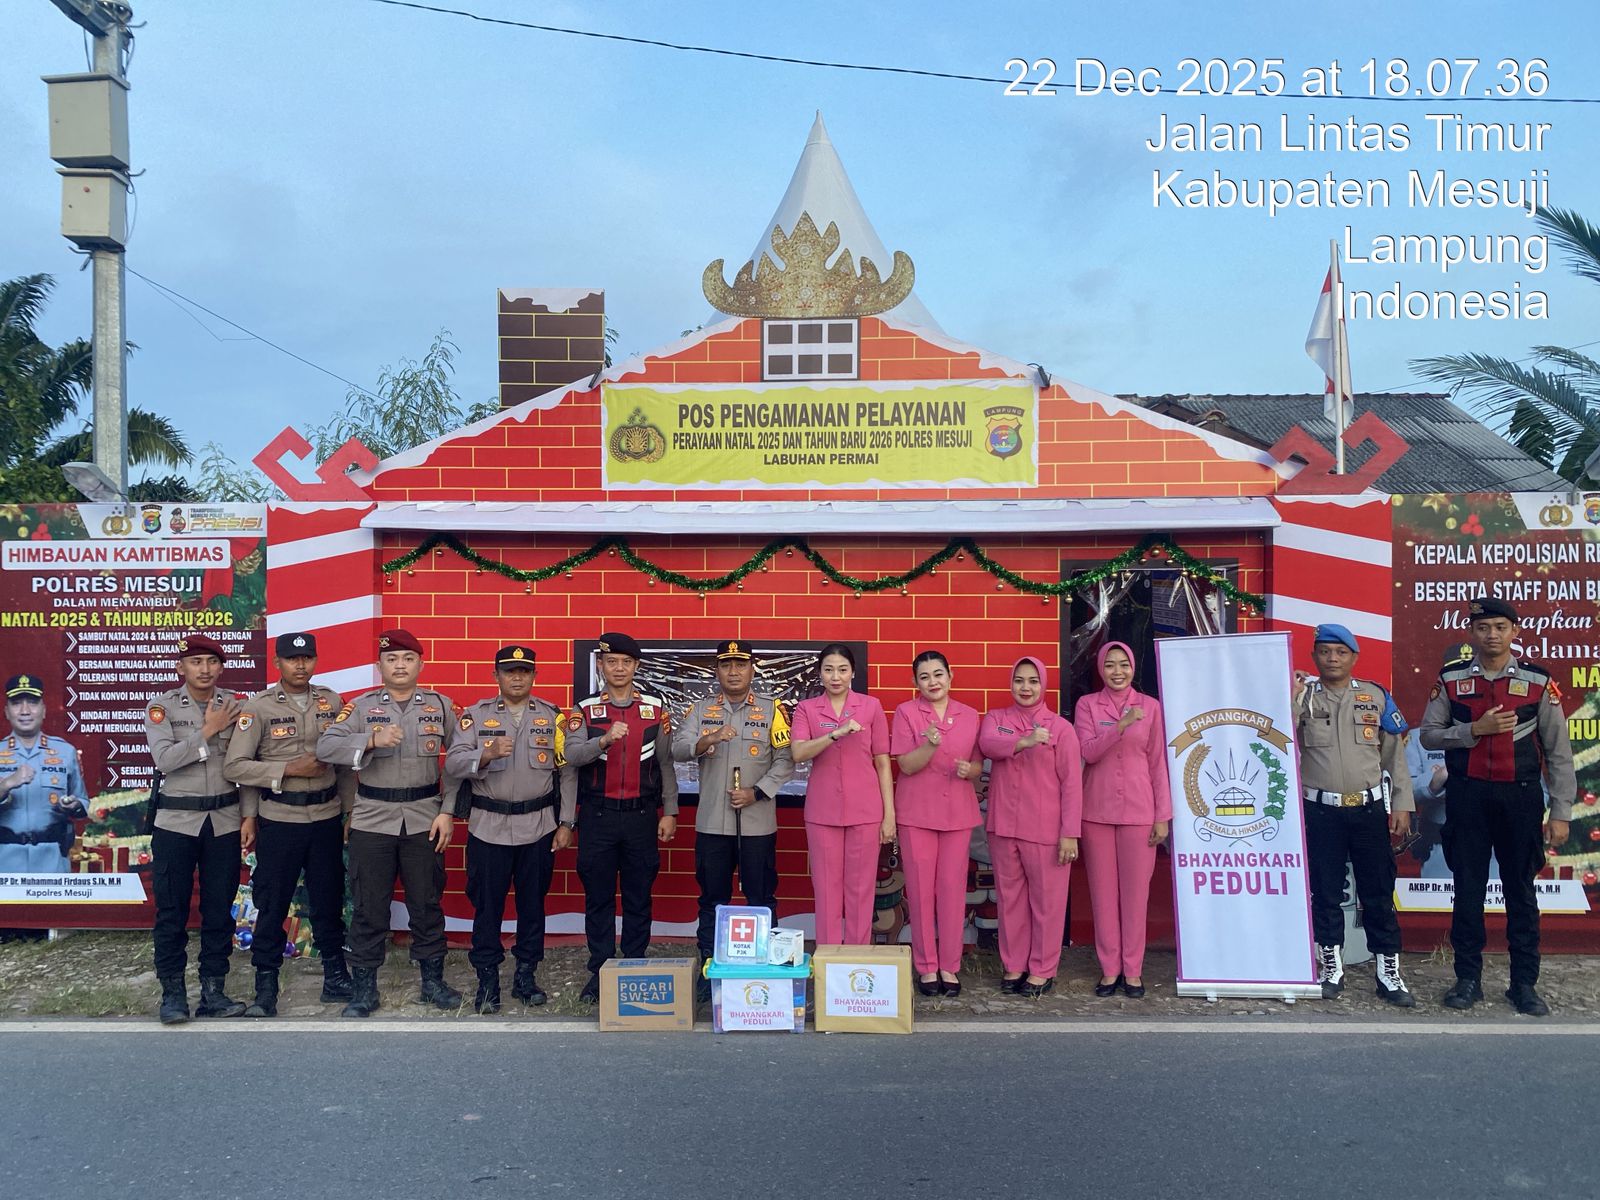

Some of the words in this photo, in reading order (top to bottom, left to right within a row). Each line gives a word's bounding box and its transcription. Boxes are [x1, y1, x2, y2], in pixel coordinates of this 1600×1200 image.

[678, 403, 715, 429] POS
[720, 402, 849, 428] PENGAMANAN
[855, 401, 966, 427] PELAYANAN
[986, 407, 1023, 416] LAMPUNG
[673, 432, 723, 450] PERAYAAN
[725, 432, 755, 449] NATAL
[757, 431, 780, 449] 2025
[782, 431, 802, 449] DAN
[805, 431, 838, 449] TAHUN
[840, 431, 867, 449] BARU
[869, 431, 892, 448] 2026
[895, 430, 933, 448] POLRES
[935, 430, 972, 448] MESUJI
[764, 453, 826, 466] LABUHAN
[829, 452, 879, 465] PERMAI
[190, 517, 263, 529] PRESISI
[8, 547, 107, 563] HIMBAUAN
[113, 546, 224, 562] KAMTIBMAS
[1414, 544, 1477, 564] KEPALA
[1482, 543, 1580, 563] KEPOLISIAN
[31, 576, 118, 593] POLRES
[125, 576, 202, 592] MESUJI
[1414, 581, 1488, 602] BESERTA
[1493, 581, 1541, 601] STAFF
[1547, 581, 1580, 600] DAN
[53, 598, 97, 608] DALAM
[100, 597, 178, 607] MENYAMBUT
[1, 612, 48, 627] NATAL
[50, 612, 88, 627] 2025
[90, 613, 101, 626] &
[103, 612, 151, 627] TAHUN
[153, 612, 193, 627] BARU
[196, 611, 234, 626] 2026
[78, 632, 107, 641] SAMBUT
[108, 632, 131, 641] NATAL
[131, 632, 149, 641] 2024
[150, 632, 157, 641] &
[157, 632, 181, 641] TAHUN
[222, 632, 252, 641] DENGAN
[78, 645, 119, 654] BERIBADAH
[120, 645, 135, 654] DAN
[137, 645, 180, 654] MELAKUKAN
[220, 645, 244, 653] OSITIF
[78, 660, 113, 669] BERSAMA
[114, 660, 147, 669] MENJAGA
[79, 673, 118, 682] TOLERANSI
[119, 674, 138, 682] UMAT
[139, 673, 179, 682] BERAGAMA
[79, 692, 100, 701] TIDAK
[101, 692, 128, 701] KONVOI
[129, 692, 144, 701] DAN
[81, 711, 110, 720] HINDARI
[418, 715, 442, 723] POLRI
[1189, 711, 1268, 732] BHAYANGKARI
[81, 724, 103, 733] DAPAT
[121, 766, 154, 775] SEBELUM
[121, 779, 149, 789] RUMAH,
[1203, 819, 1238, 836] KEMALA
[1238, 819, 1271, 836] HIKMAH
[1178, 853, 1301, 868] BHAYANGKARI
[10, 878, 20, 886] Dr.
[21, 878, 63, 886] Muhammad
[64, 878, 91, 886] Firdaus
[108, 878, 122, 886] M.H
[1194, 871, 1288, 895] PEDULI
[1409, 883, 1430, 892] AKBP
[1432, 883, 1443, 892] Dr.
[1545, 885, 1560, 893] M.H
[26, 889, 62, 898] Kapolres
[64, 889, 93, 898] Mesuji
[620, 982, 672, 992] POCARI
[620, 992, 667, 1001] SWEAT
[834, 998, 889, 1006] BHAYANGKARI
